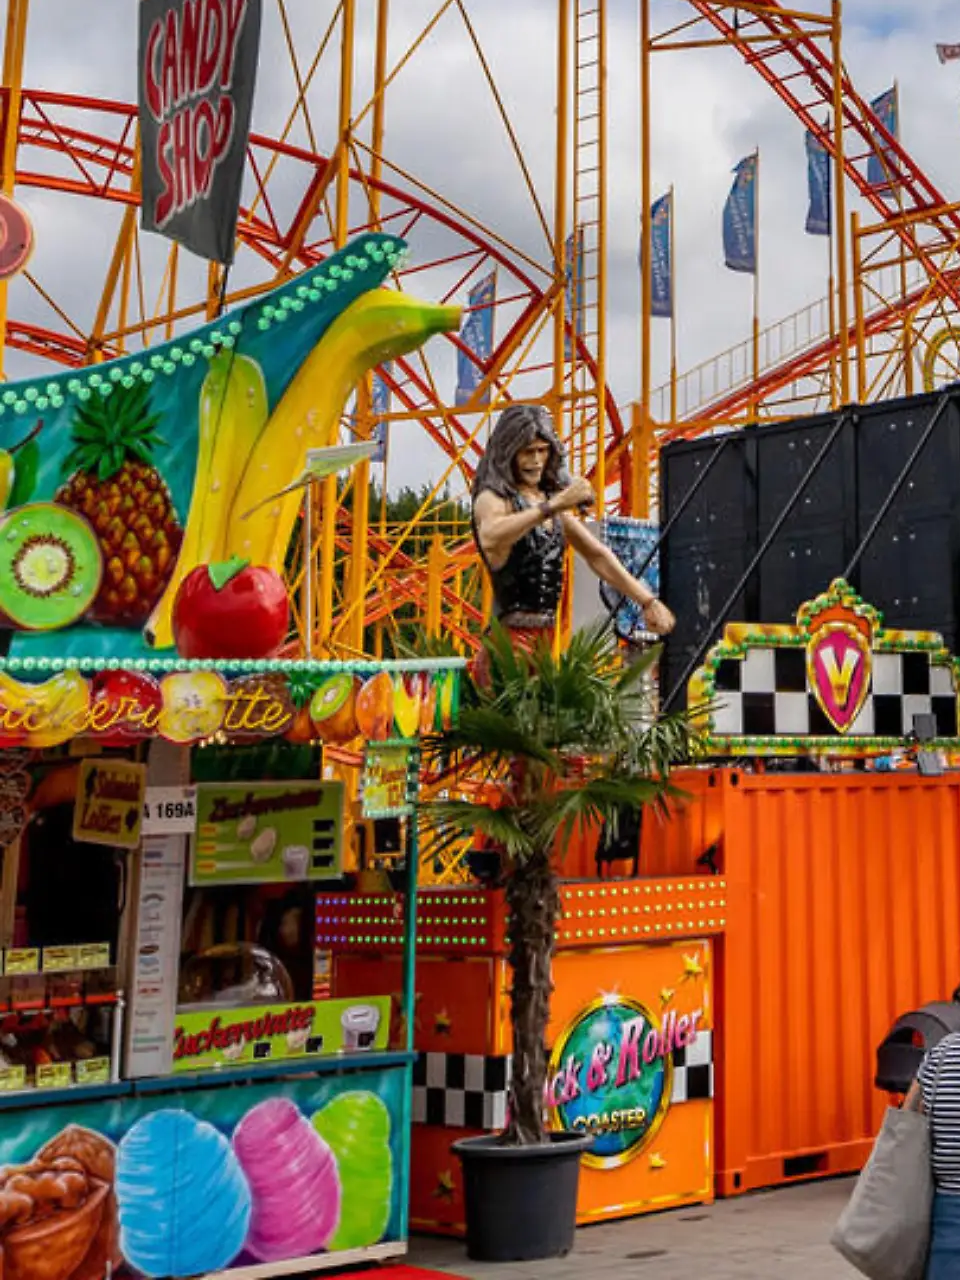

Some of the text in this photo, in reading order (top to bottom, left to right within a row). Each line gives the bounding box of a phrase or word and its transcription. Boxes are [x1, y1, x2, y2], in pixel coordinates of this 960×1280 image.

[155, 96, 235, 228] SHOP
[819, 645, 861, 711] V
[157, 801, 195, 819] 169A
[586, 1041, 613, 1091] &
[615, 1009, 702, 1089] Roller
[573, 1107, 646, 1136] COASTER
